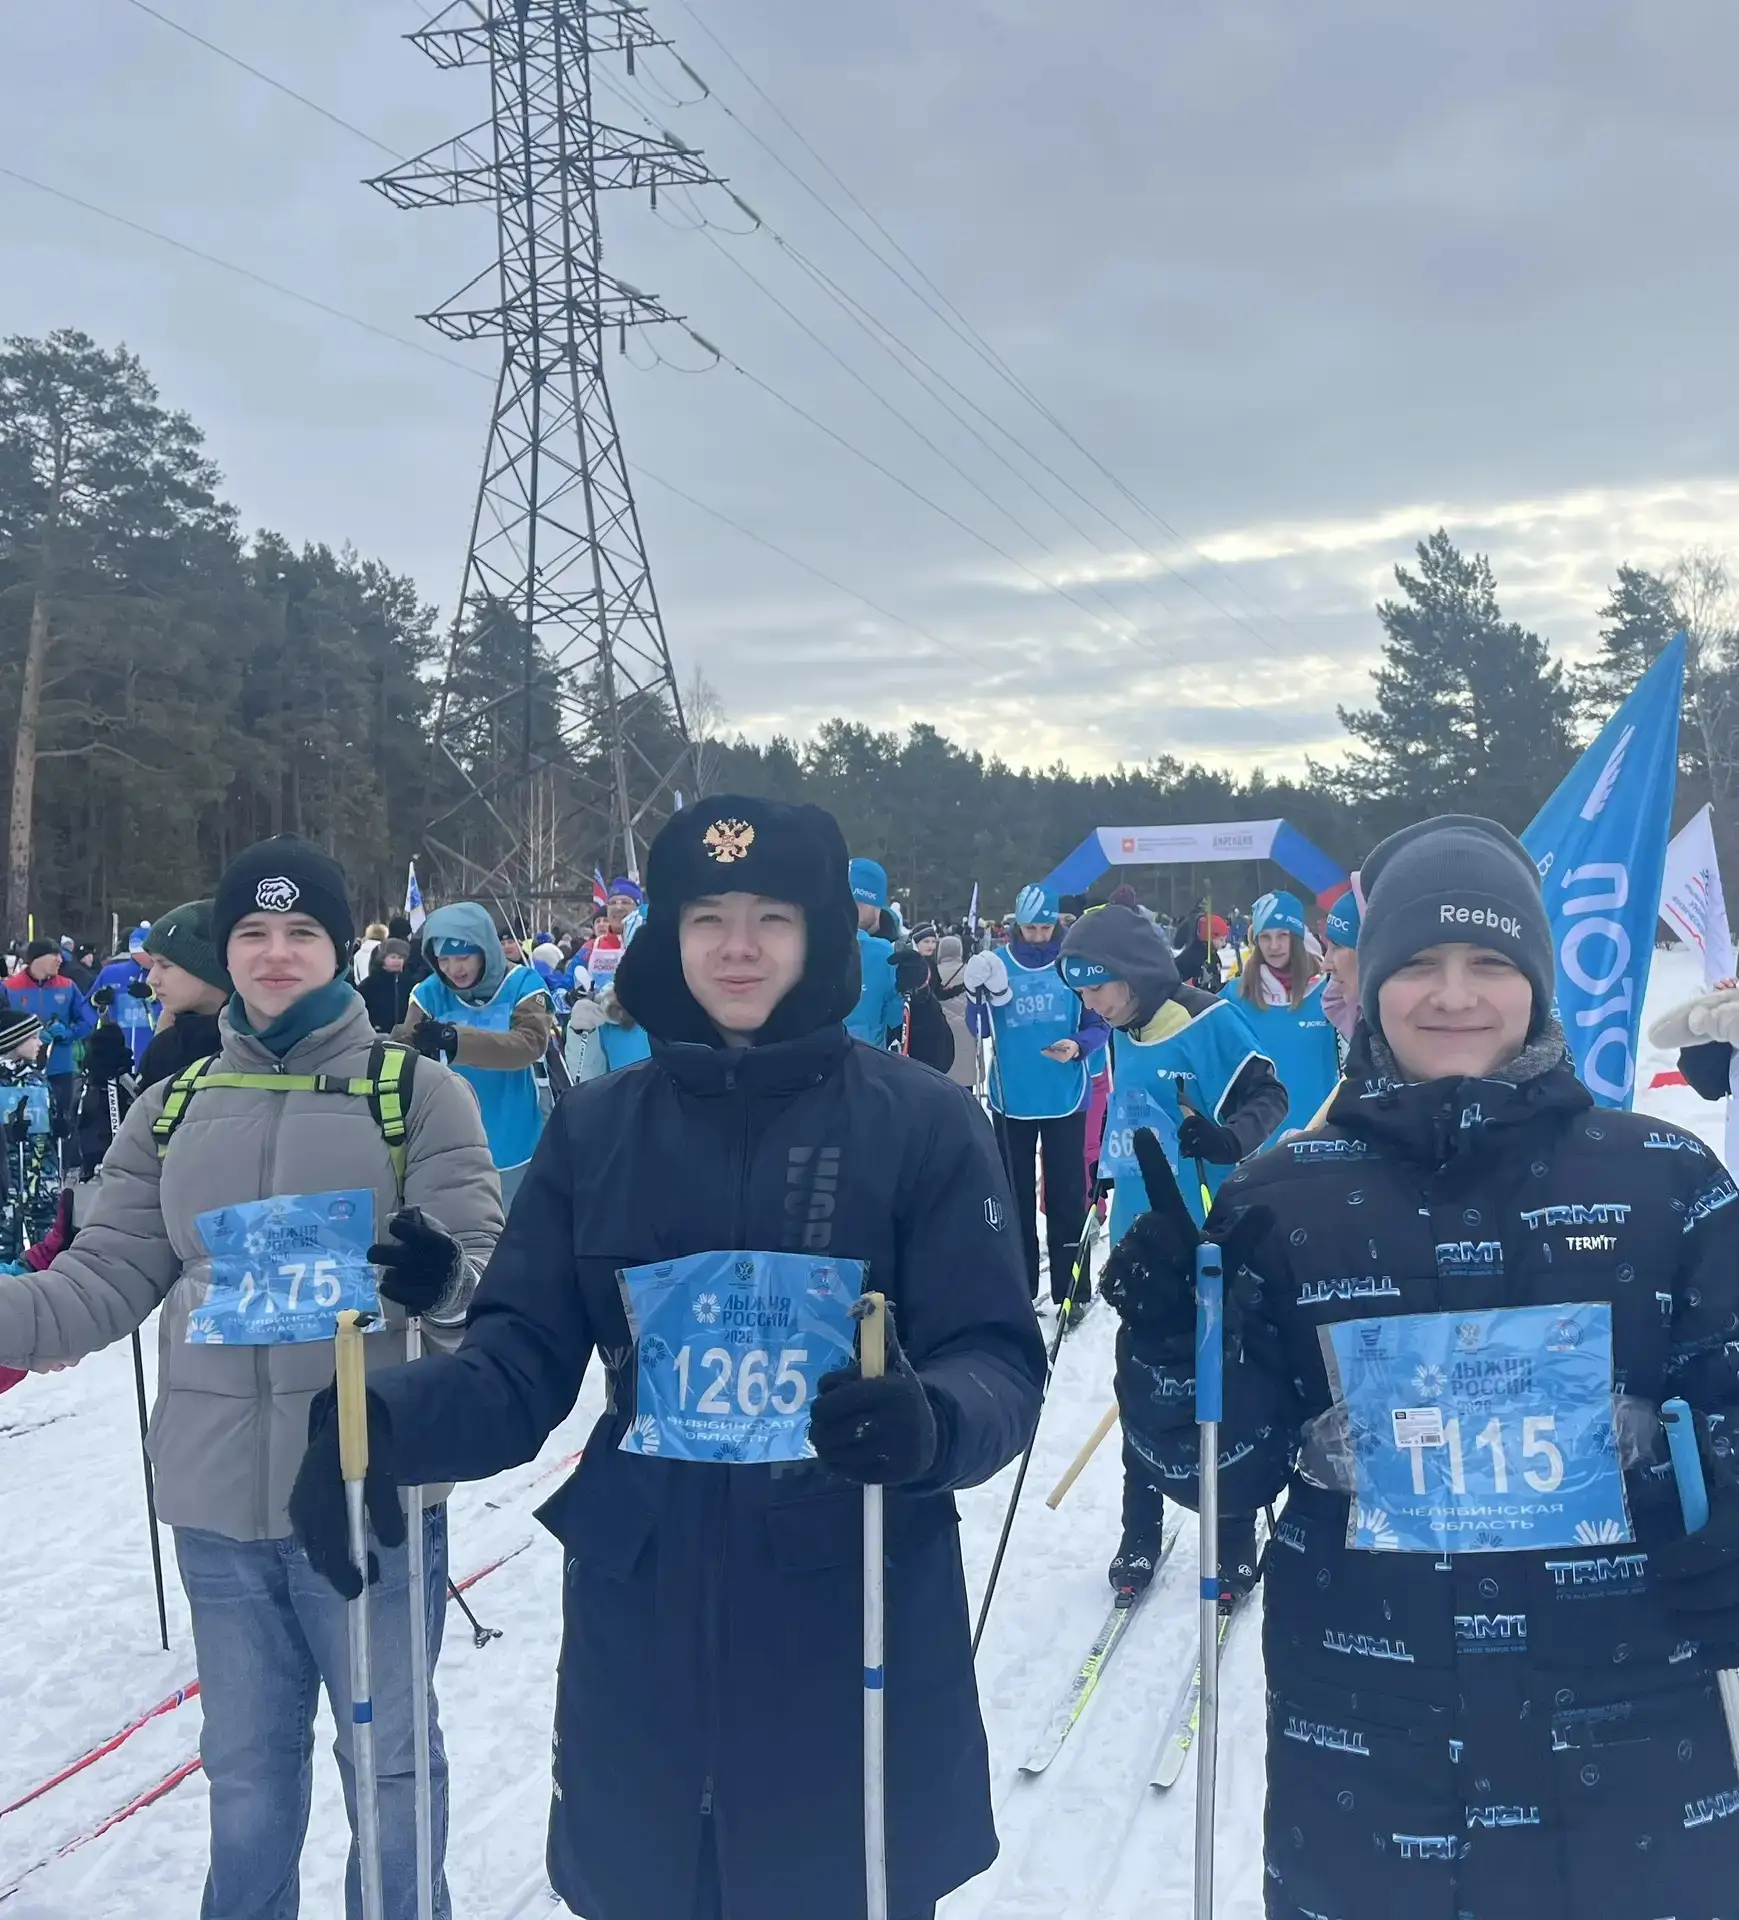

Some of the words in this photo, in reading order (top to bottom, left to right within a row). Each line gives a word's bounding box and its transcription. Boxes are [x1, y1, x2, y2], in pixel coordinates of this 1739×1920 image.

[1440, 904, 1521, 939] Reebok
[1560, 862, 1635, 1109] ЛОТО
[1015, 993, 1055, 1015] 6387
[1520, 1203, 1631, 1230] TRMT
[1297, 1275, 1400, 1305] TRMT
[722, 1310, 789, 1327] РОССИИ
[673, 1345, 808, 1416] 1265
[1451, 1357, 1532, 1378] ЛЫЖНЯ
[1451, 1378, 1532, 1397] РОССИИ
[1402, 1503, 1564, 1517] ЧЕЛЯБИНСКАЯ
[1429, 1519, 1534, 1531] ОБЛАСТЬ
[1545, 1553, 1649, 1585] TRMT
[1323, 1628, 1414, 1664] TRMT
[1283, 1716, 1370, 1757] TRMT
